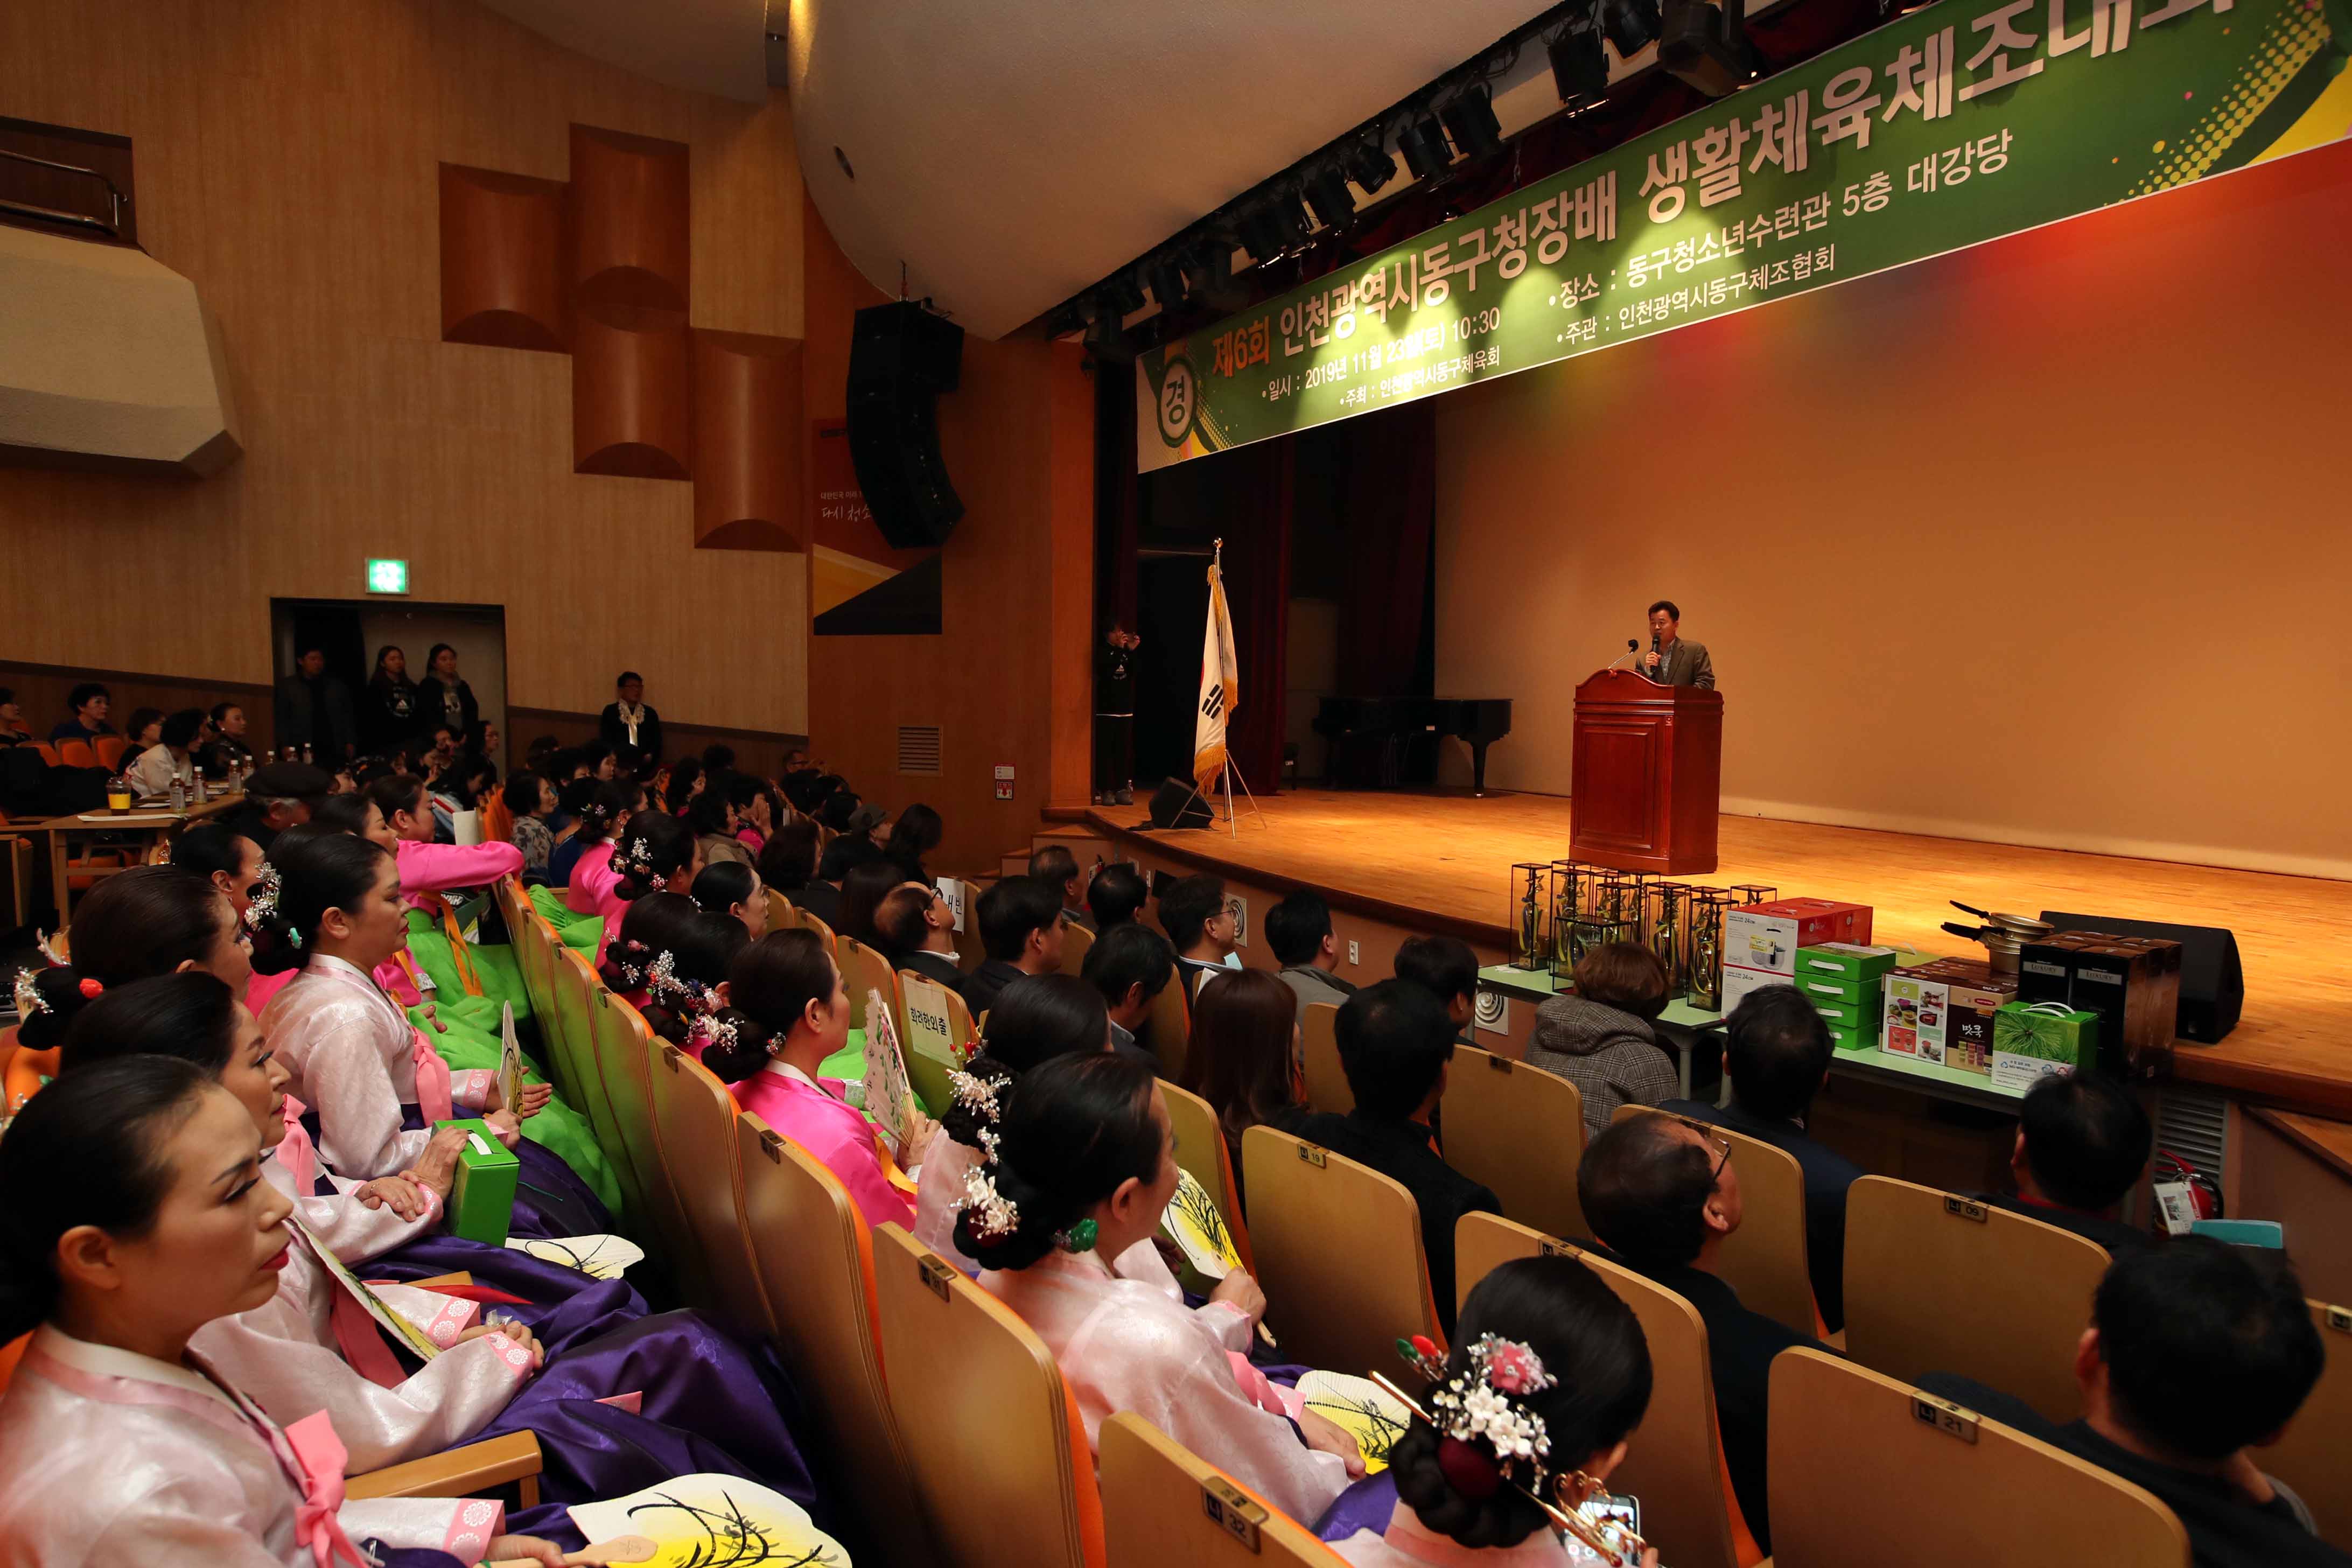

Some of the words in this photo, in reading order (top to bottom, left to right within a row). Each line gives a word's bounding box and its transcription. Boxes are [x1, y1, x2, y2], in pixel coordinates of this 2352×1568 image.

[1560, 273, 1600, 308] 장소
[1626, 192, 1831, 289] 동구청소년수련관
[1843, 172, 1893, 216] 5층
[1907, 129, 2013, 193] 대강당
[1212, 316, 1270, 377] 제6회
[1280, 170, 1616, 357] 인천광역시동구청장배
[1565, 317, 1598, 345] 주관
[1618, 244, 1835, 331] 인천광역시동구체조협회
[1166, 378, 1185, 425] 경
[1269, 376, 1291, 401] 일시
[1305, 357, 1347, 389] 2019년
[1353, 346, 1382, 374] 11월
[1452, 307, 1501, 342] 10:30
[1346, 385, 1367, 407] 주최
